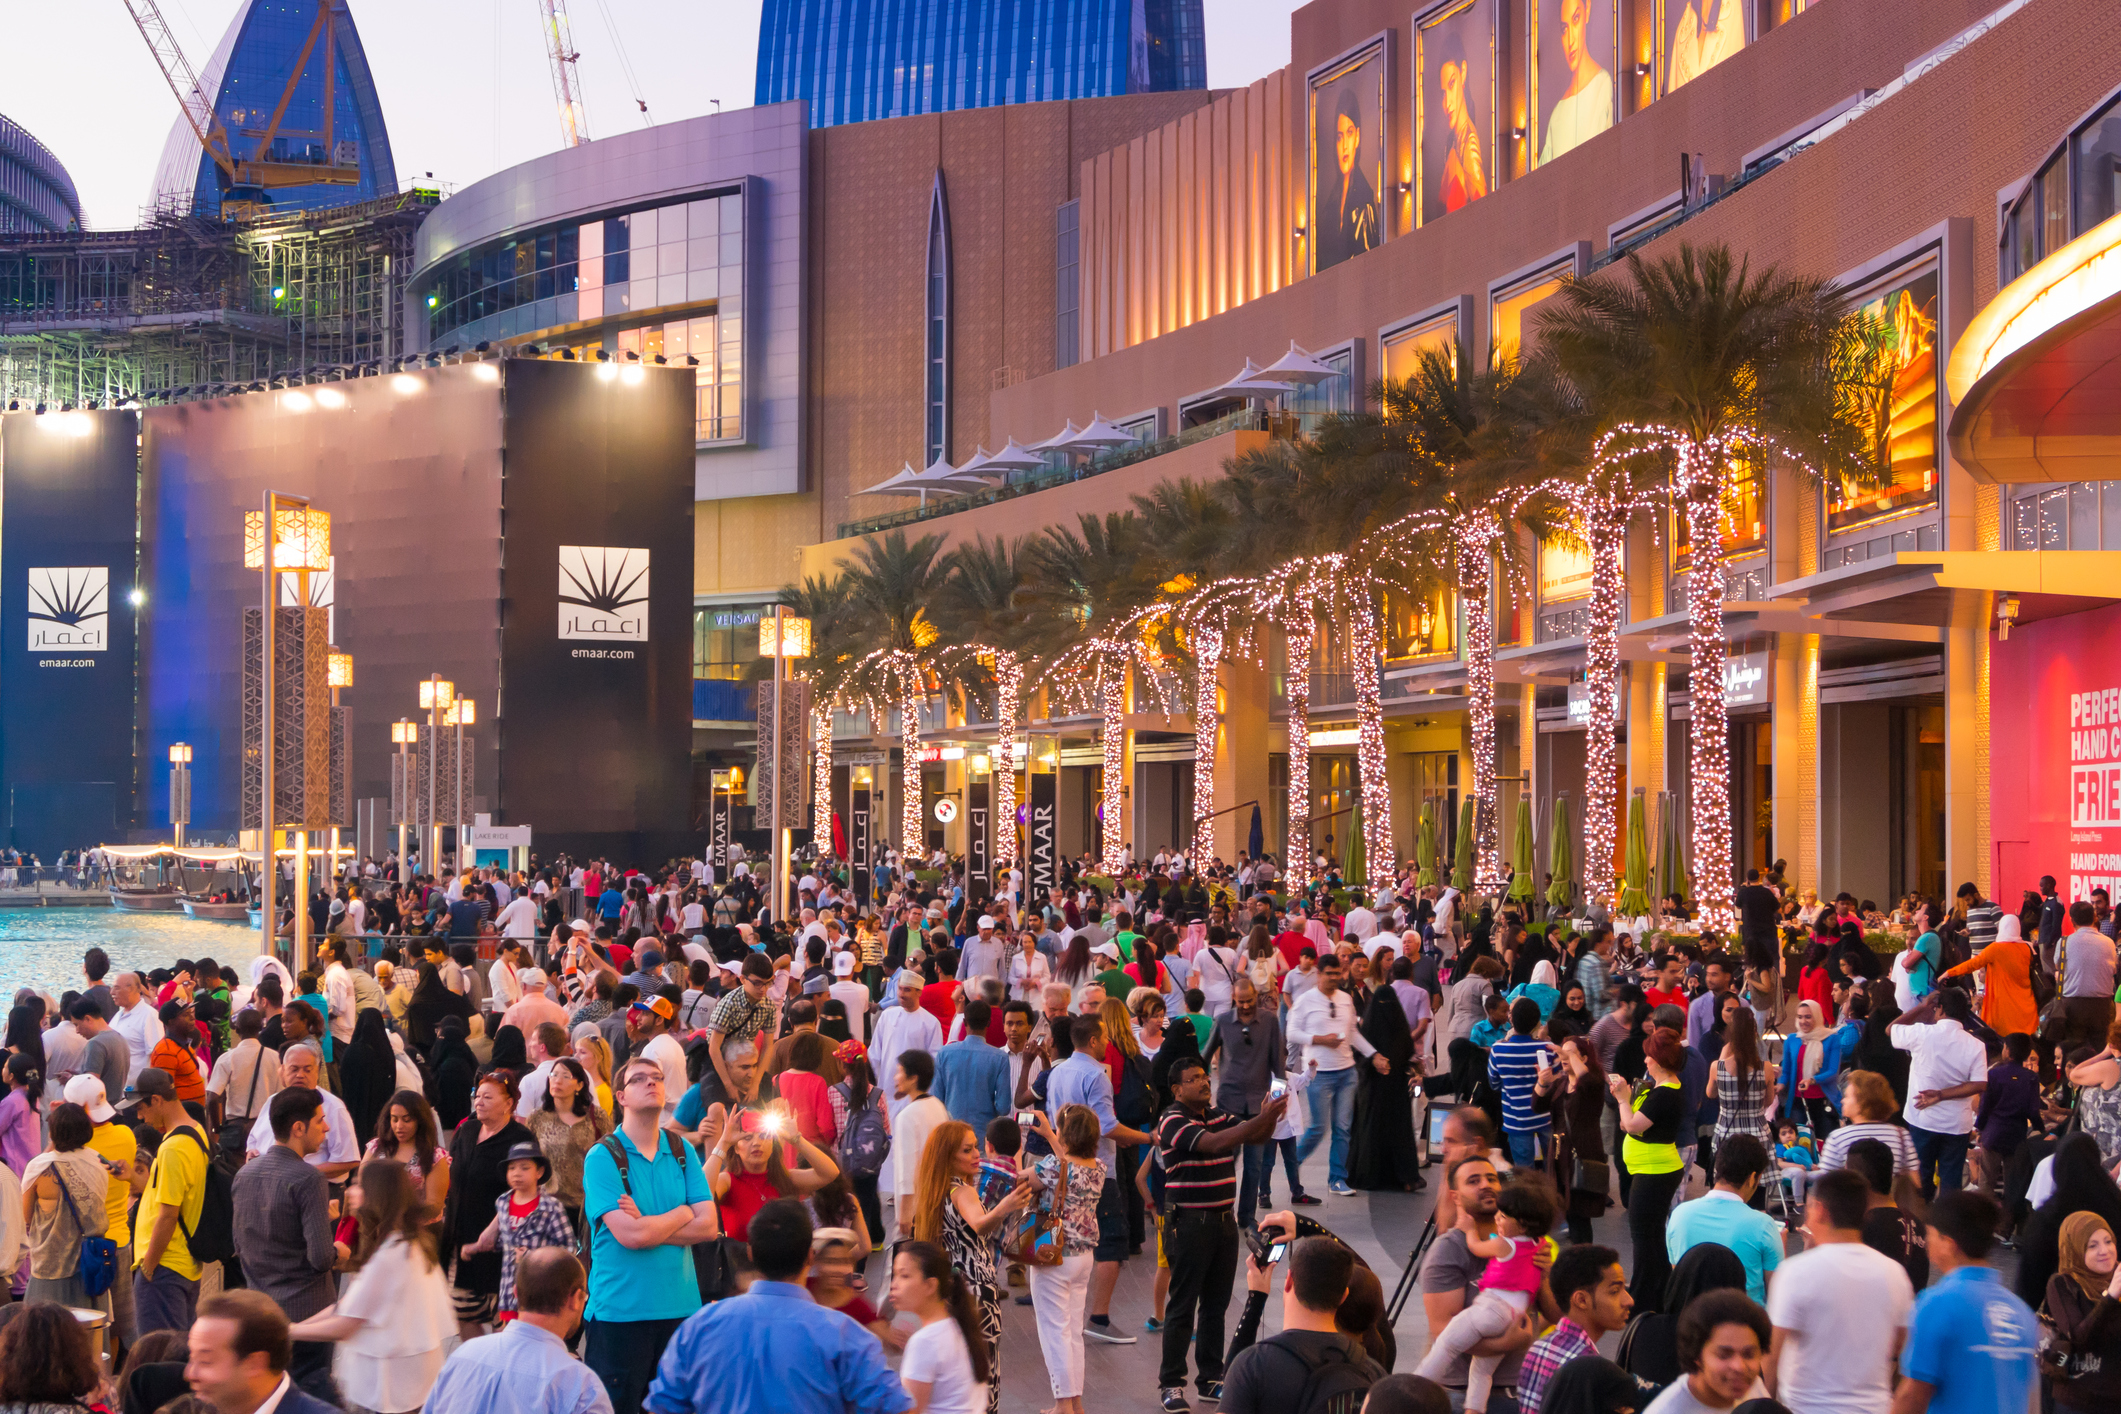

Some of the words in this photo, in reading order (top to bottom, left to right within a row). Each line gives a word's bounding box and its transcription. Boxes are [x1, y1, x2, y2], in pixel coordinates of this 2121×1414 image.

[715, 613, 763, 626] VERSAC
[571, 649, 635, 659] emaar.com
[39, 659, 95, 668] emaar.com
[2070, 728, 2108, 761] HAND
[715, 811, 727, 867] EMAAR
[1033, 803, 1053, 902] EMAAR
[2070, 853, 2097, 870] HAND
